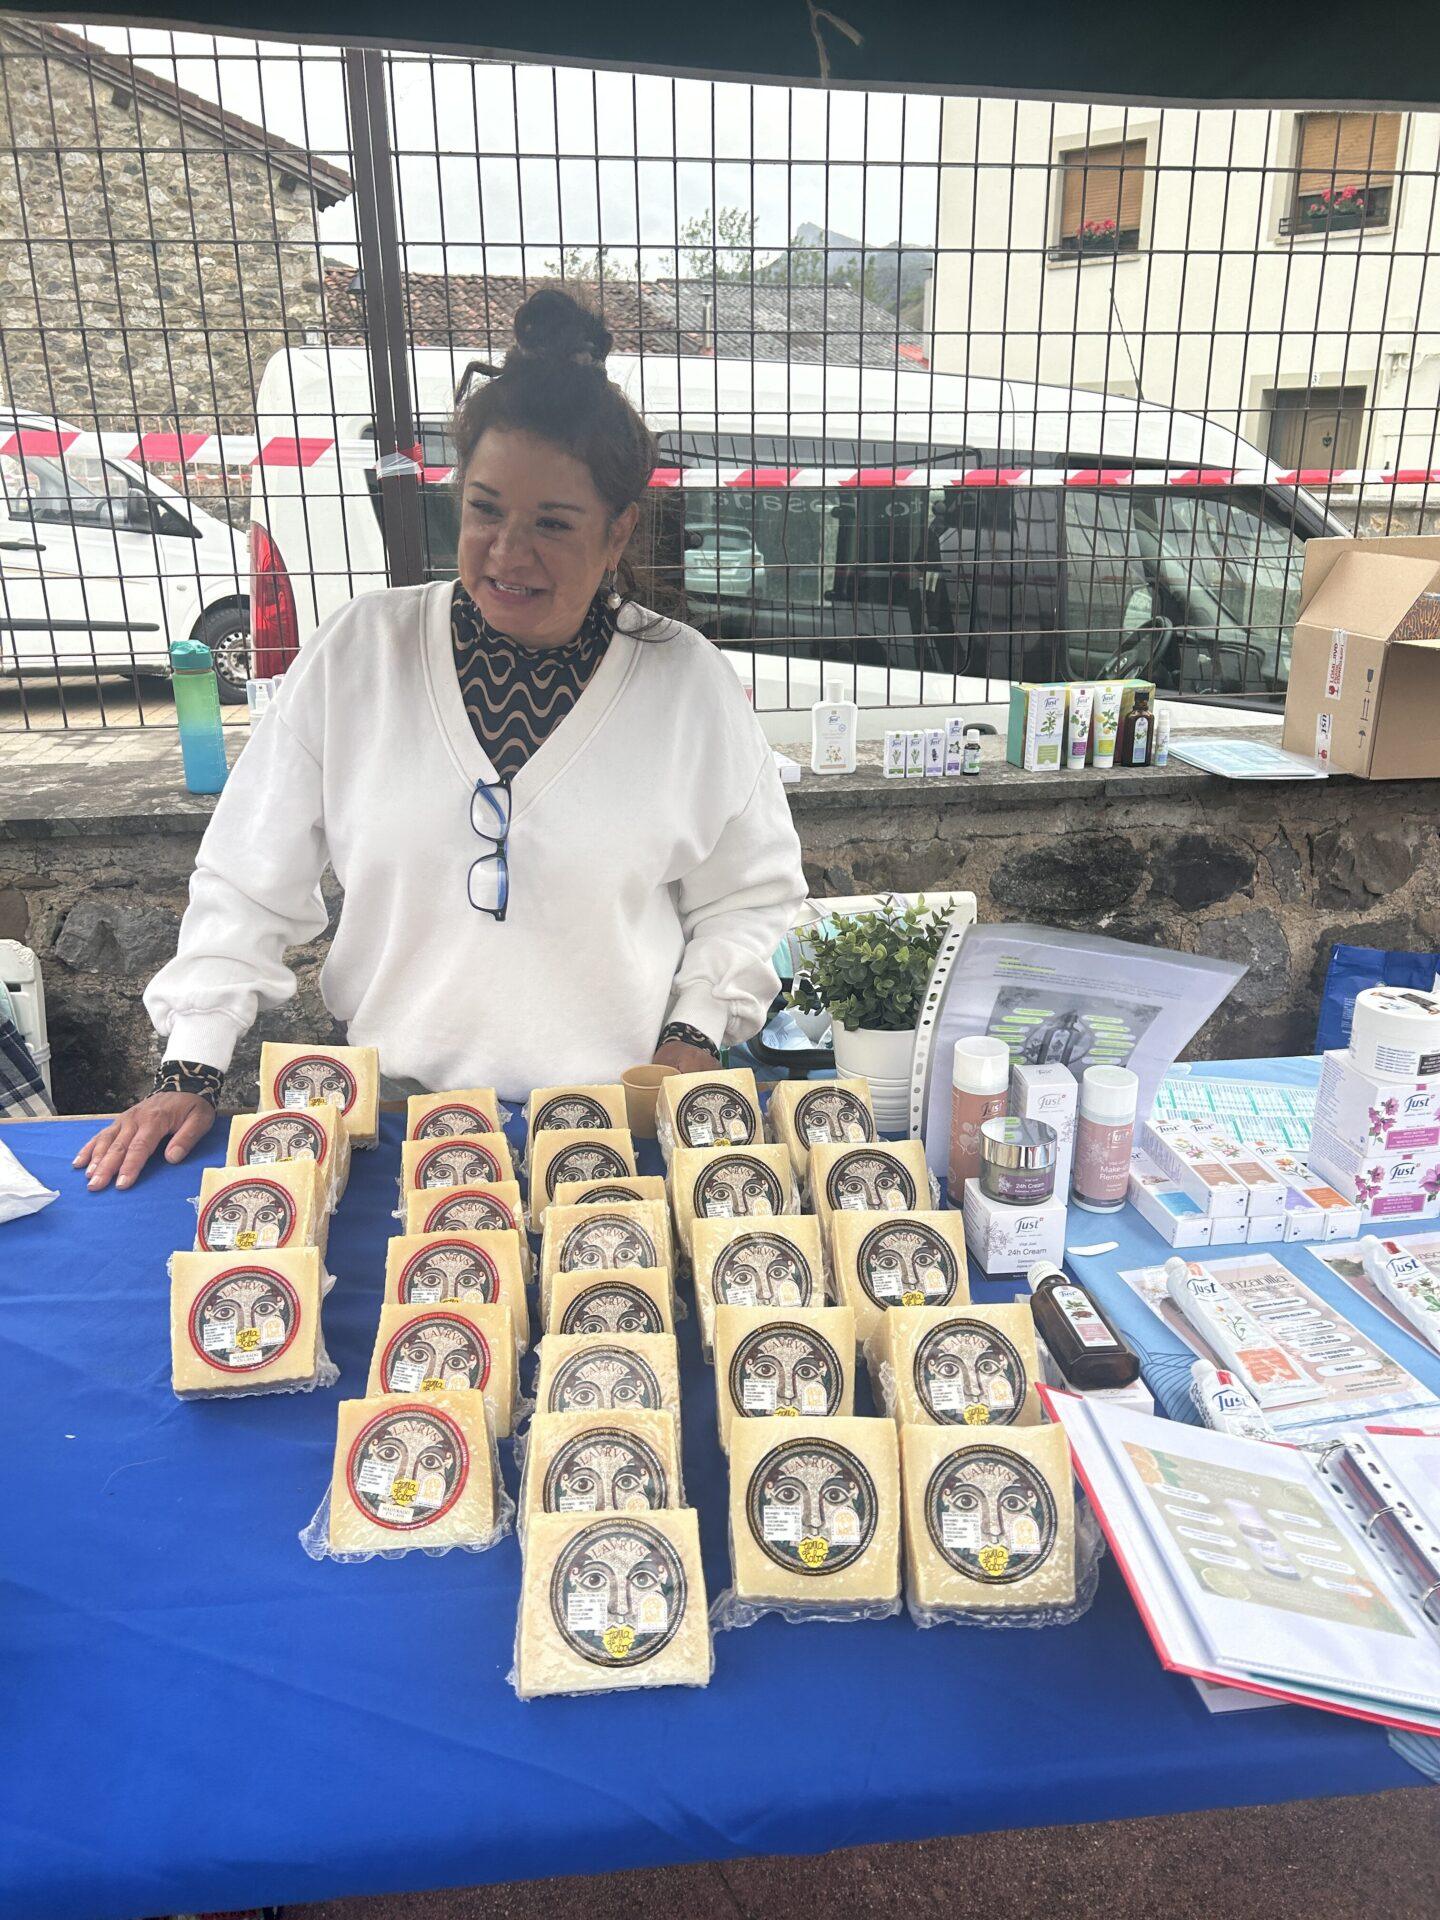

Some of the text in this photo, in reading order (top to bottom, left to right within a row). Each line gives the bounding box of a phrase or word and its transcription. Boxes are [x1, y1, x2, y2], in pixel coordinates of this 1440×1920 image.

[1039, 1096, 1062, 1110] Just
[1405, 1097, 1430, 1112] Just
[1391, 1167, 1415, 1181] Just
[234, 1190, 272, 1204] LAVRVS
[450, 1203, 486, 1219] LAVRVS
[1016, 1217, 1040, 1234] Just
[882, 1234, 922, 1248] LAVRVS
[430, 1253, 472, 1267] LAVRVS
[737, 1247, 778, 1262] LAVRVS
[1023, 1248, 1047, 1256] Cream
[1391, 1258, 1420, 1278] Just
[221, 1282, 267, 1298] LAVRVS
[1192, 1279, 1218, 1294] Just
[1221, 1274, 1288, 1290] anzanilla
[588, 1297, 630, 1314] LAVRVS
[422, 1328, 466, 1346] LAVRVS
[941, 1335, 988, 1350] LAVRVS
[763, 1337, 810, 1354] LAVRVS
[579, 1362, 626, 1379] LAVRVS
[1218, 1395, 1247, 1411] Just
[392, 1422, 441, 1442] LAVRVS
[579, 1447, 630, 1466] LAVRVS
[784, 1457, 837, 1475] LAVRVS
[961, 1465, 1014, 1482] LAVRVS
[591, 1540, 649, 1559] LAVRVS
